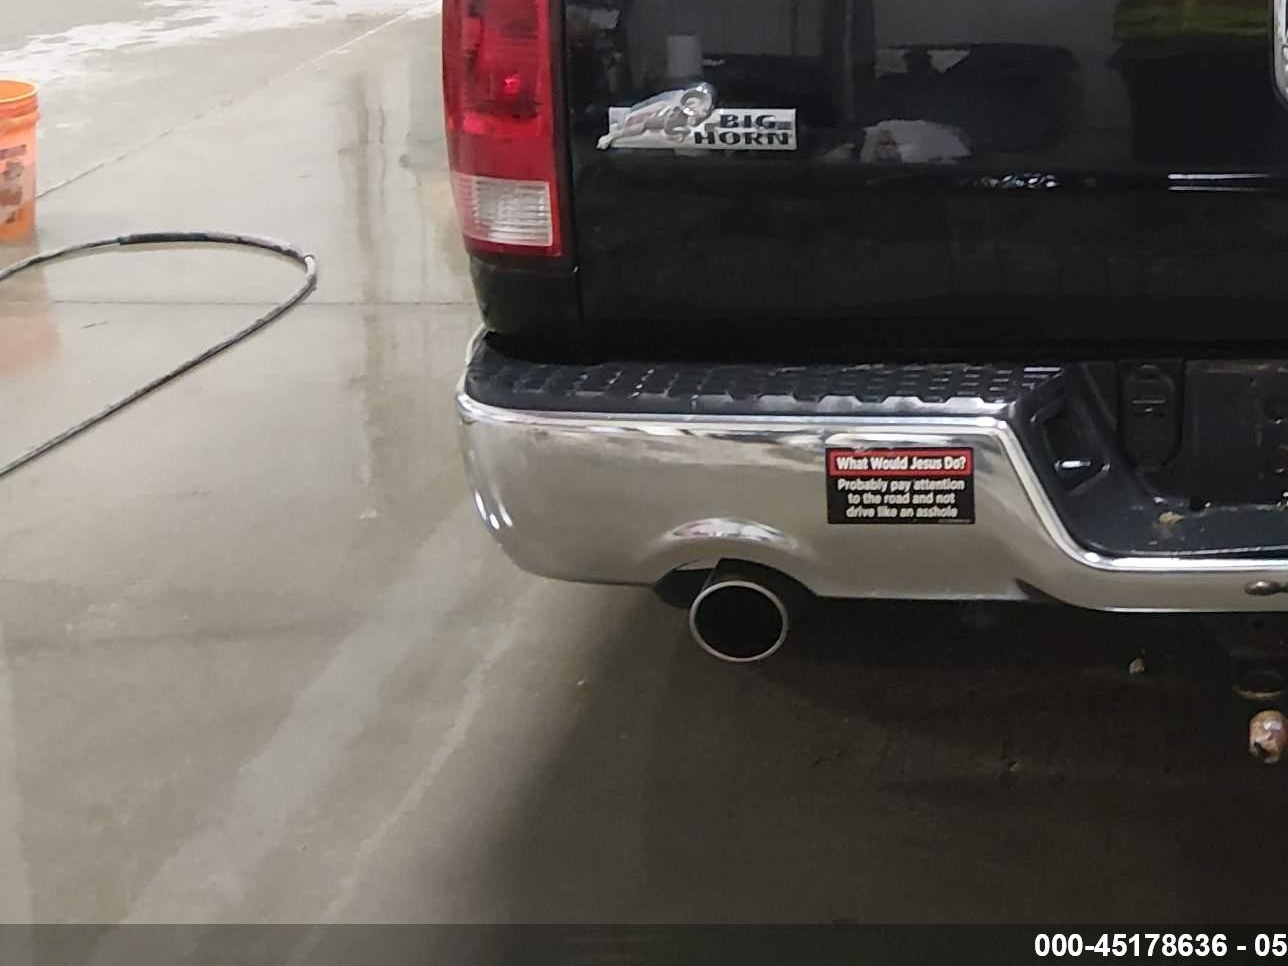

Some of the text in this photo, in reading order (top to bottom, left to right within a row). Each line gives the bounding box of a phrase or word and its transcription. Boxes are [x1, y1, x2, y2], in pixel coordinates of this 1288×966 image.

[719, 114, 776, 130] BIG
[694, 131, 790, 146] HORN
[836, 455, 966, 470] What Would Jesus Do?
[837, 478, 965, 493] Probably pay attention
[848, 492, 955, 505] to the road and not
[846, 505, 958, 518] drive like an asshole
